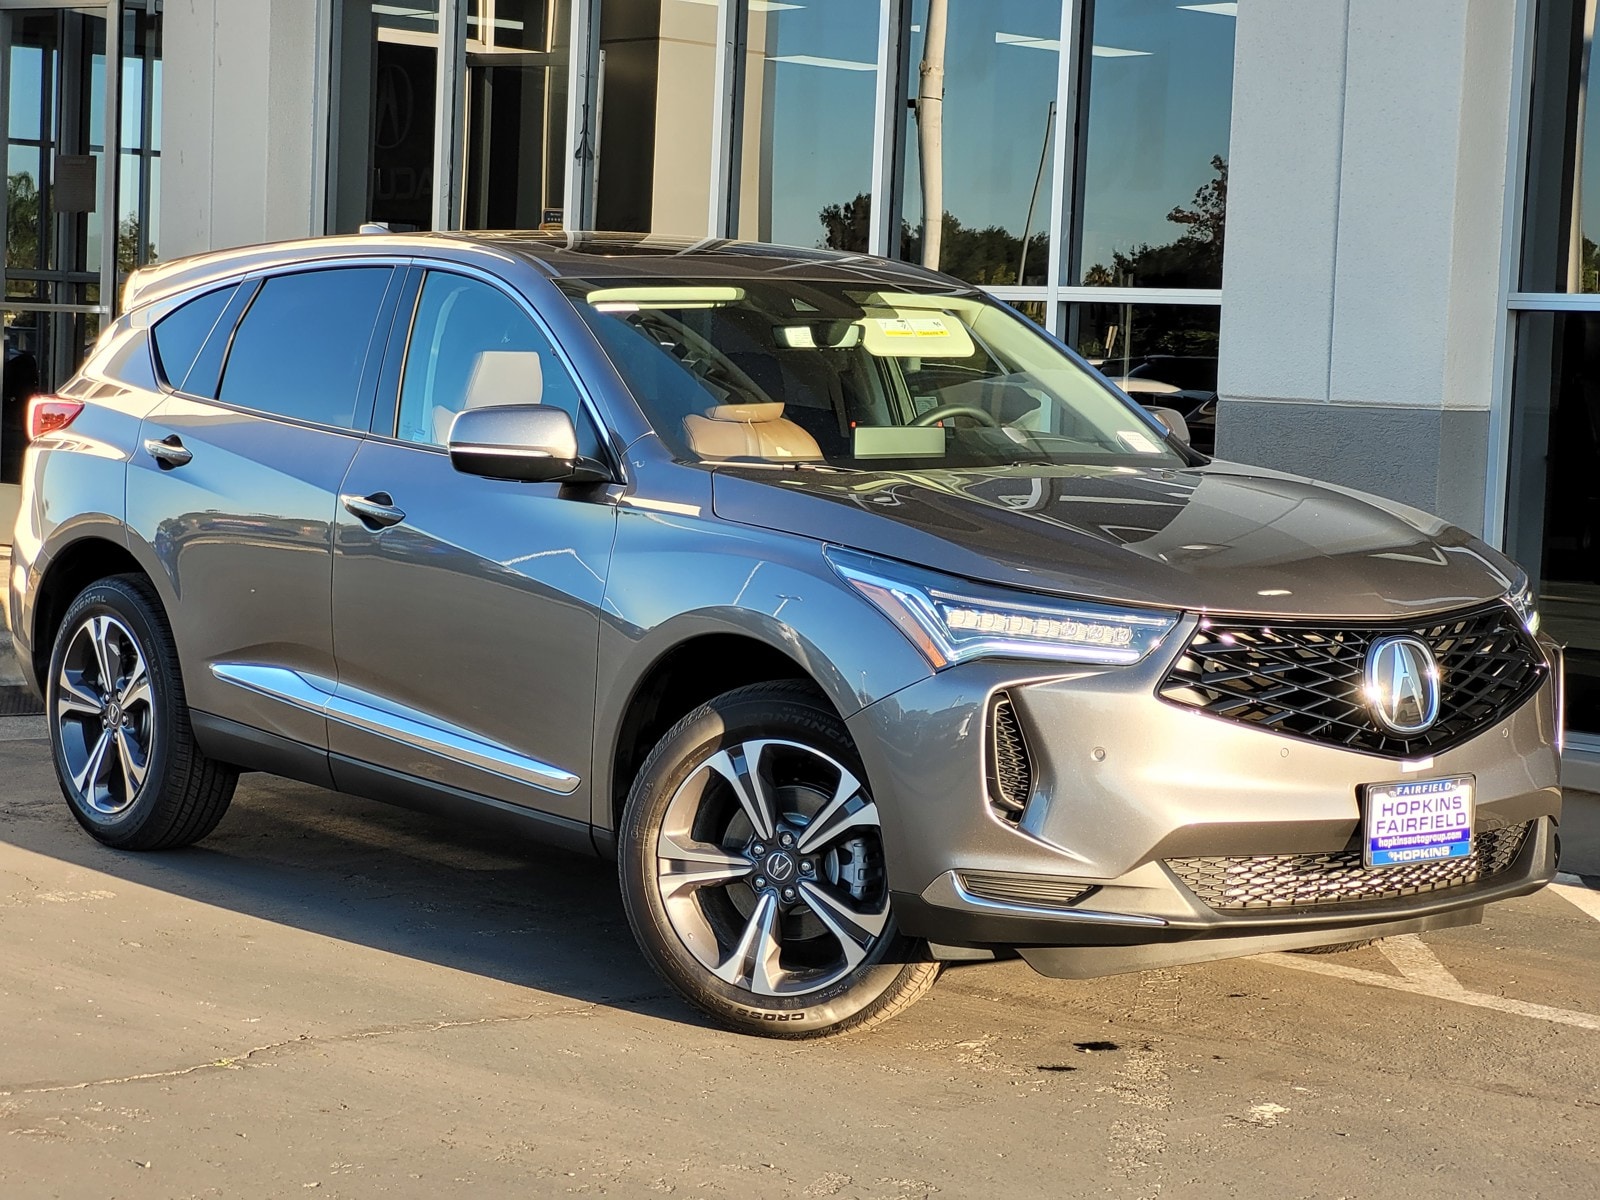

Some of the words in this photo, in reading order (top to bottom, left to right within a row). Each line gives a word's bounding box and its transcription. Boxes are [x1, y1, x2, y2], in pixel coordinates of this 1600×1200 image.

[1396, 782, 1452, 795] FAIRFIELD
[1382, 796, 1462, 818] HOPKINS
[1376, 812, 1467, 835] FAIRFIELD
[1378, 831, 1462, 849] hopkinsautogroup.com
[1393, 846, 1450, 861] HOPKINS
[735, 1007, 804, 1022] CROSS
